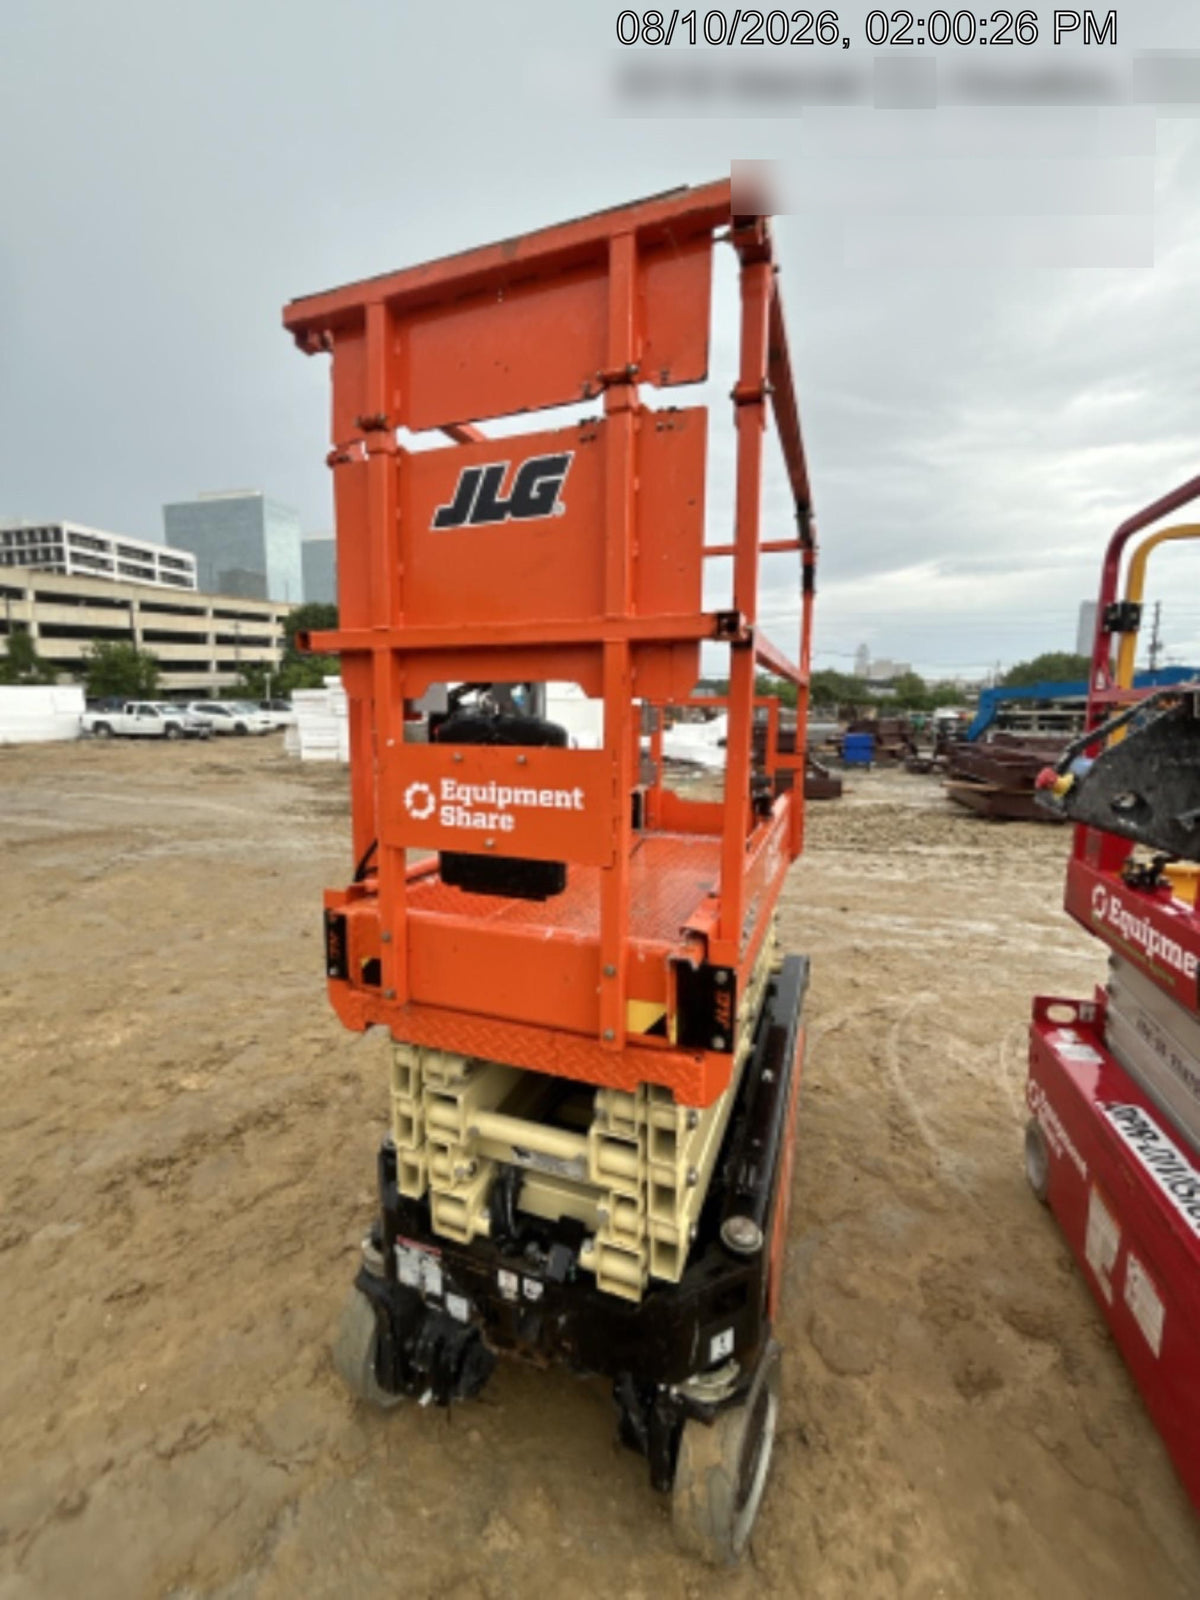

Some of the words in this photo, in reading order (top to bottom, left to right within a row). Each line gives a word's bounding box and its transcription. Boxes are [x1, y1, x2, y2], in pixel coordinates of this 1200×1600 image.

[430, 450, 575, 531] JLG
[440, 778, 585, 810] Equipment
[440, 805, 515, 832] Share
